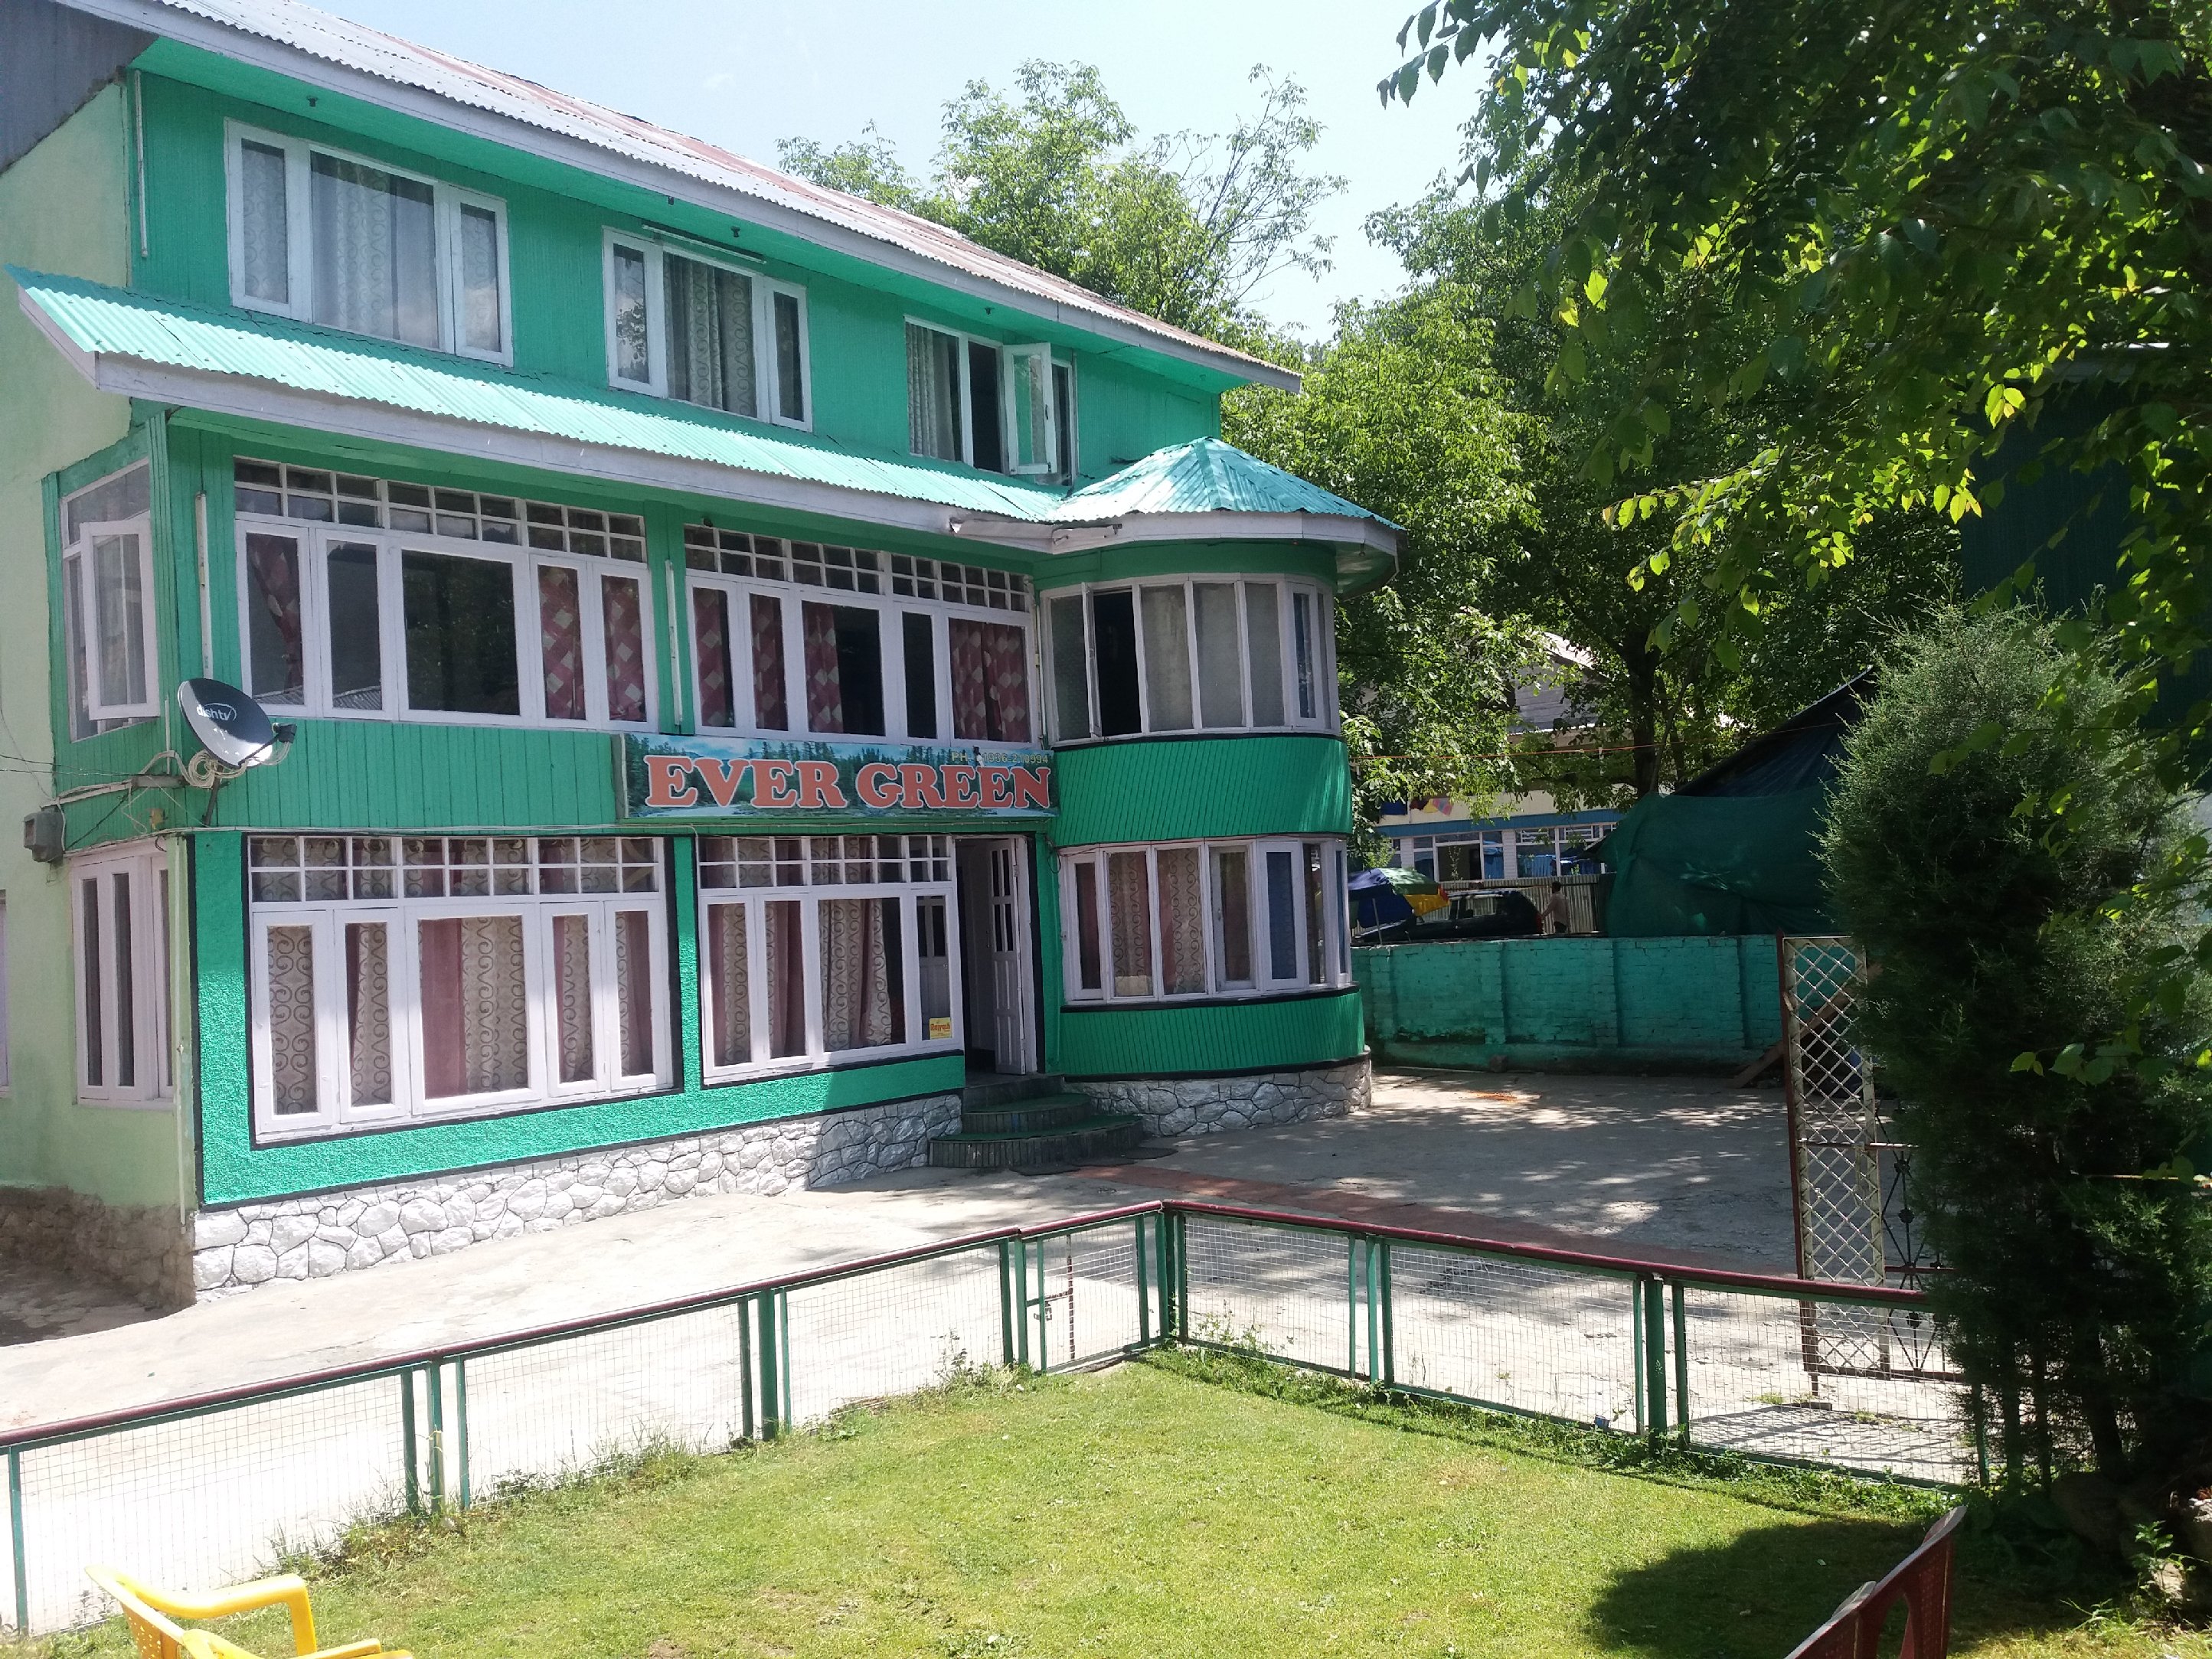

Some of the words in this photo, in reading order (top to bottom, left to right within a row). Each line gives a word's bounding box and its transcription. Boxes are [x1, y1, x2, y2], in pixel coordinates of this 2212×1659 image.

[196, 704, 233, 721] dishtv
[977, 752, 1049, 764] 1936-210994
[643, 755, 848, 808] EVER
[855, 763, 1051, 809] GREEN
